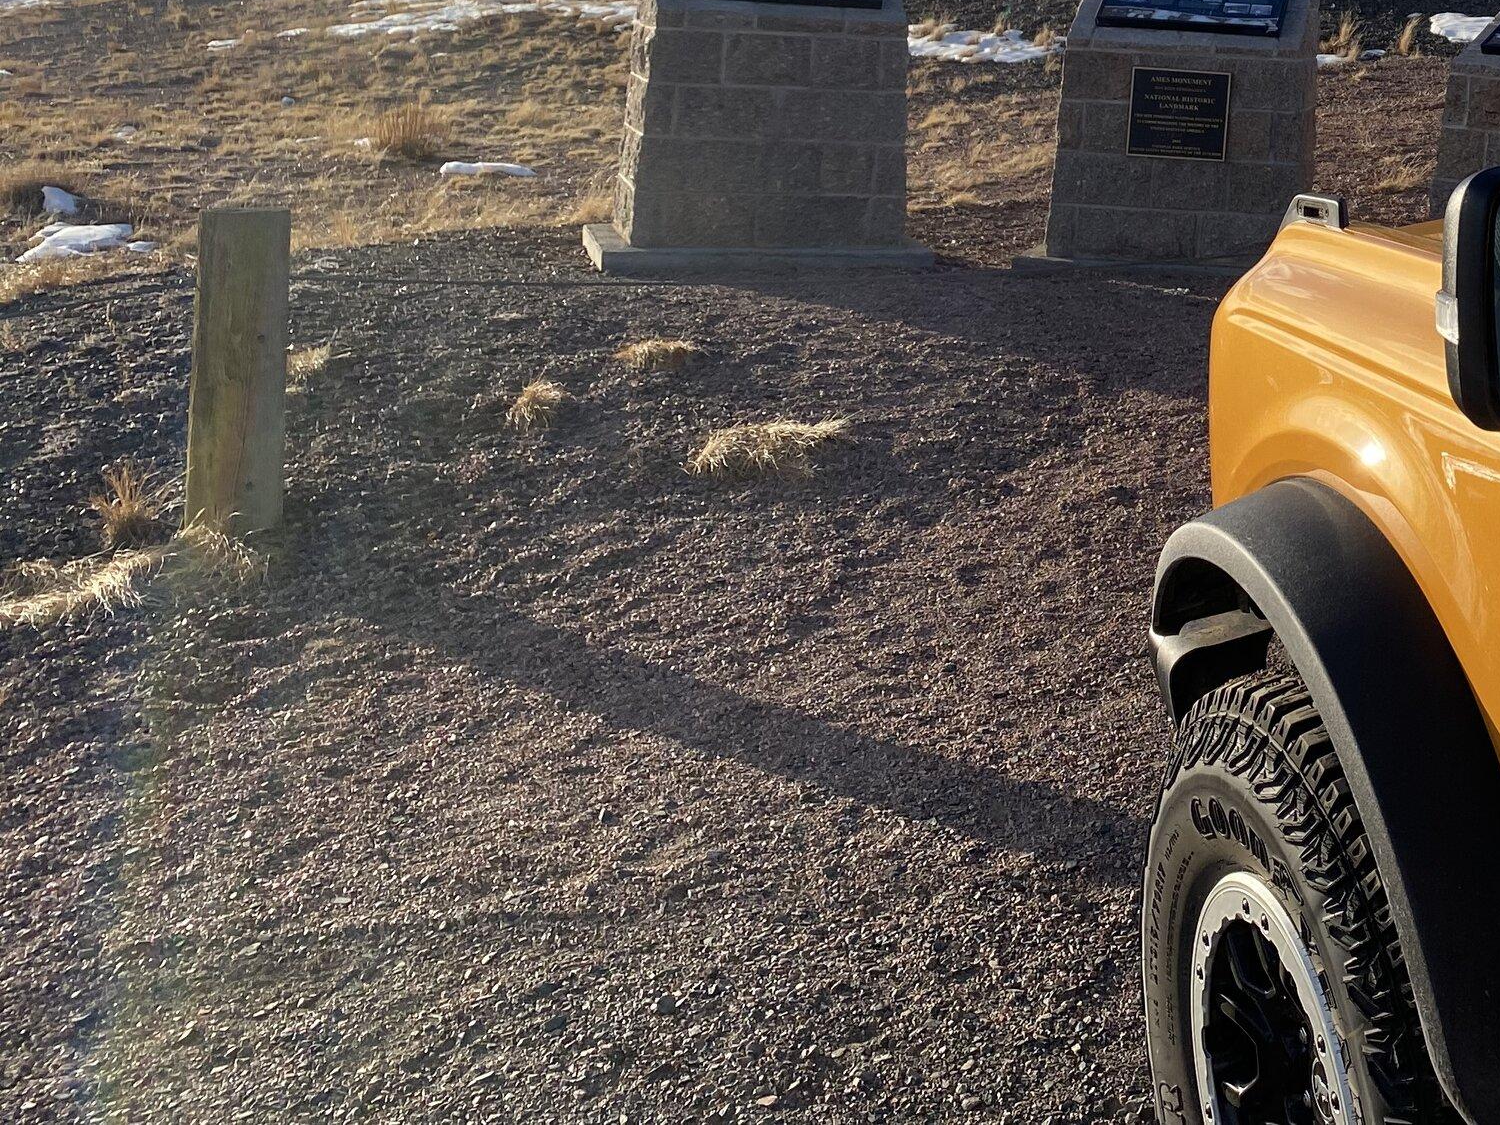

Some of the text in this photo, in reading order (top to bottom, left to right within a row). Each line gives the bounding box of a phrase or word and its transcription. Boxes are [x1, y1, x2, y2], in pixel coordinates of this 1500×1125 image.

[1171, 77, 1212, 86] MONUMENT
[1144, 94, 1216, 104] NATIONAL HISTORIC
[1159, 103, 1199, 111] LANDMARK
